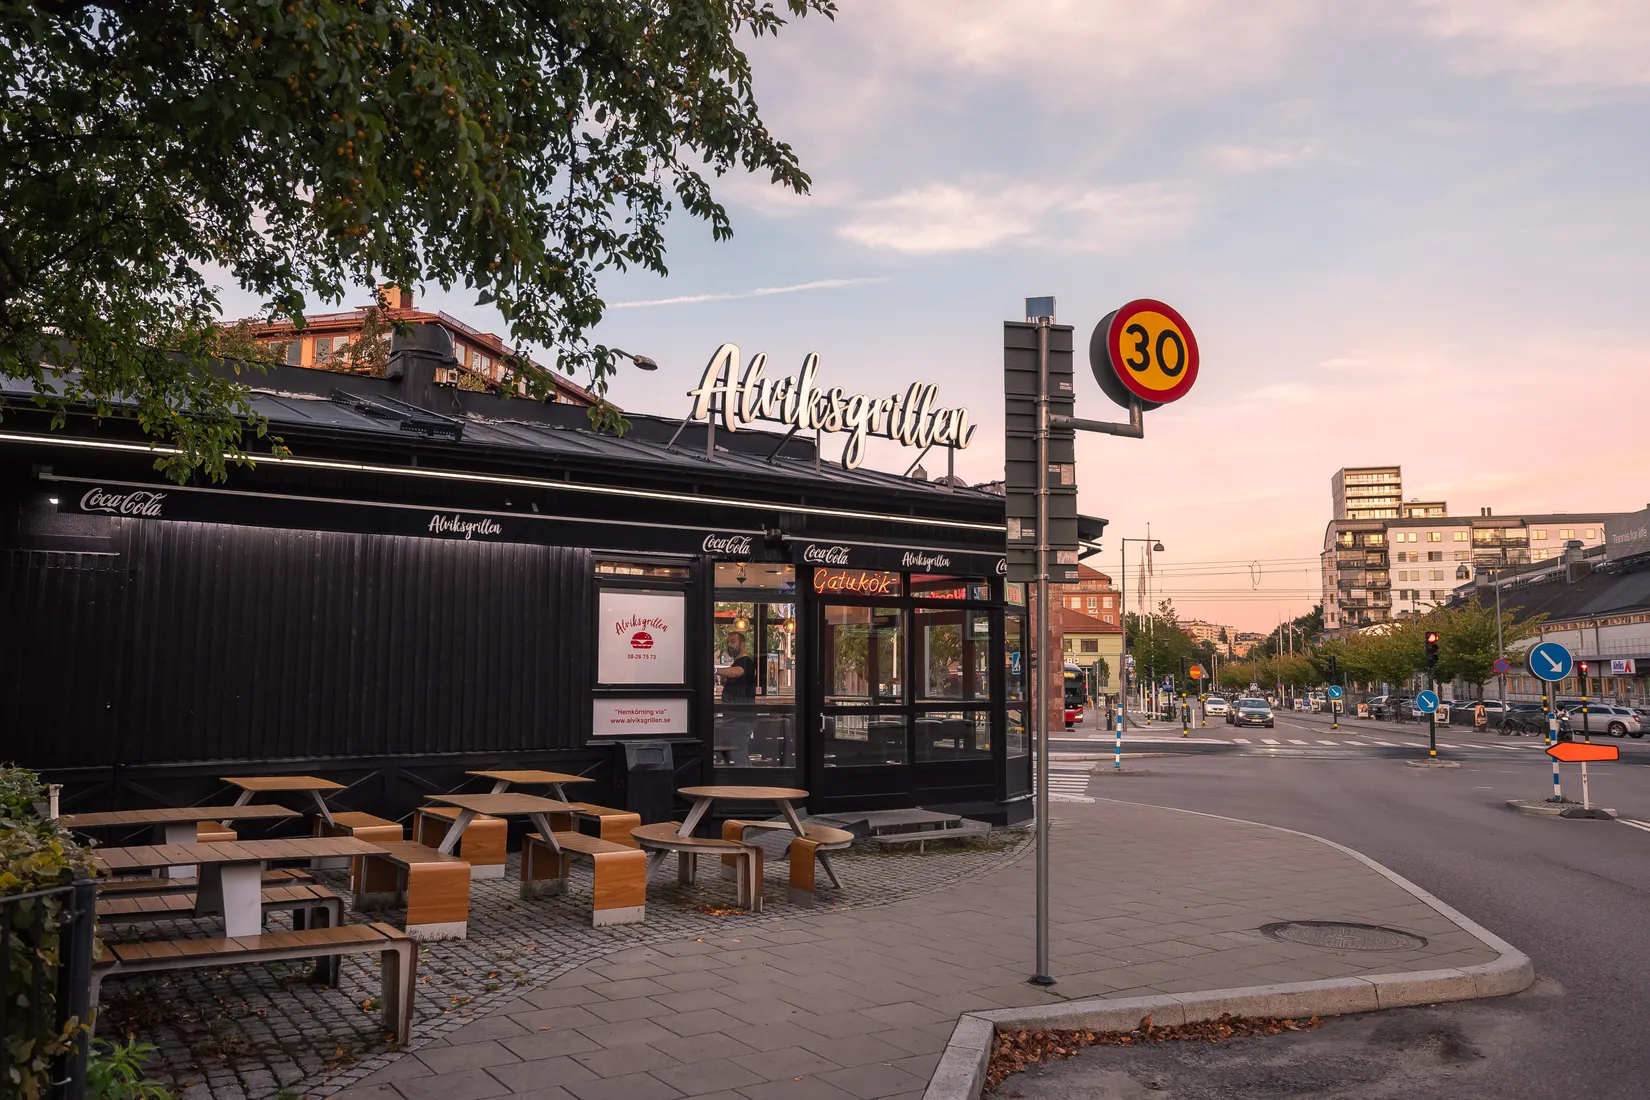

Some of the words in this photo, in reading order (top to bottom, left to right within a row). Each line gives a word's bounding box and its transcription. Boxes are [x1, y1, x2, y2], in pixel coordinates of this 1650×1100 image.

[1126, 323, 1185, 377] 30
[687, 342, 977, 470] Alviksgrillen
[80, 487, 167, 516] Coca-Cola
[428, 514, 502, 540] Alviksgrillen
[702, 534, 753, 554] Coca-Cola
[803, 544, 850, 564] Coca-Cola
[901, 551, 950, 572] Alviksgrillen
[814, 568, 890, 593] Gatukök
[615, 613, 668, 635] Alviksgrillen
